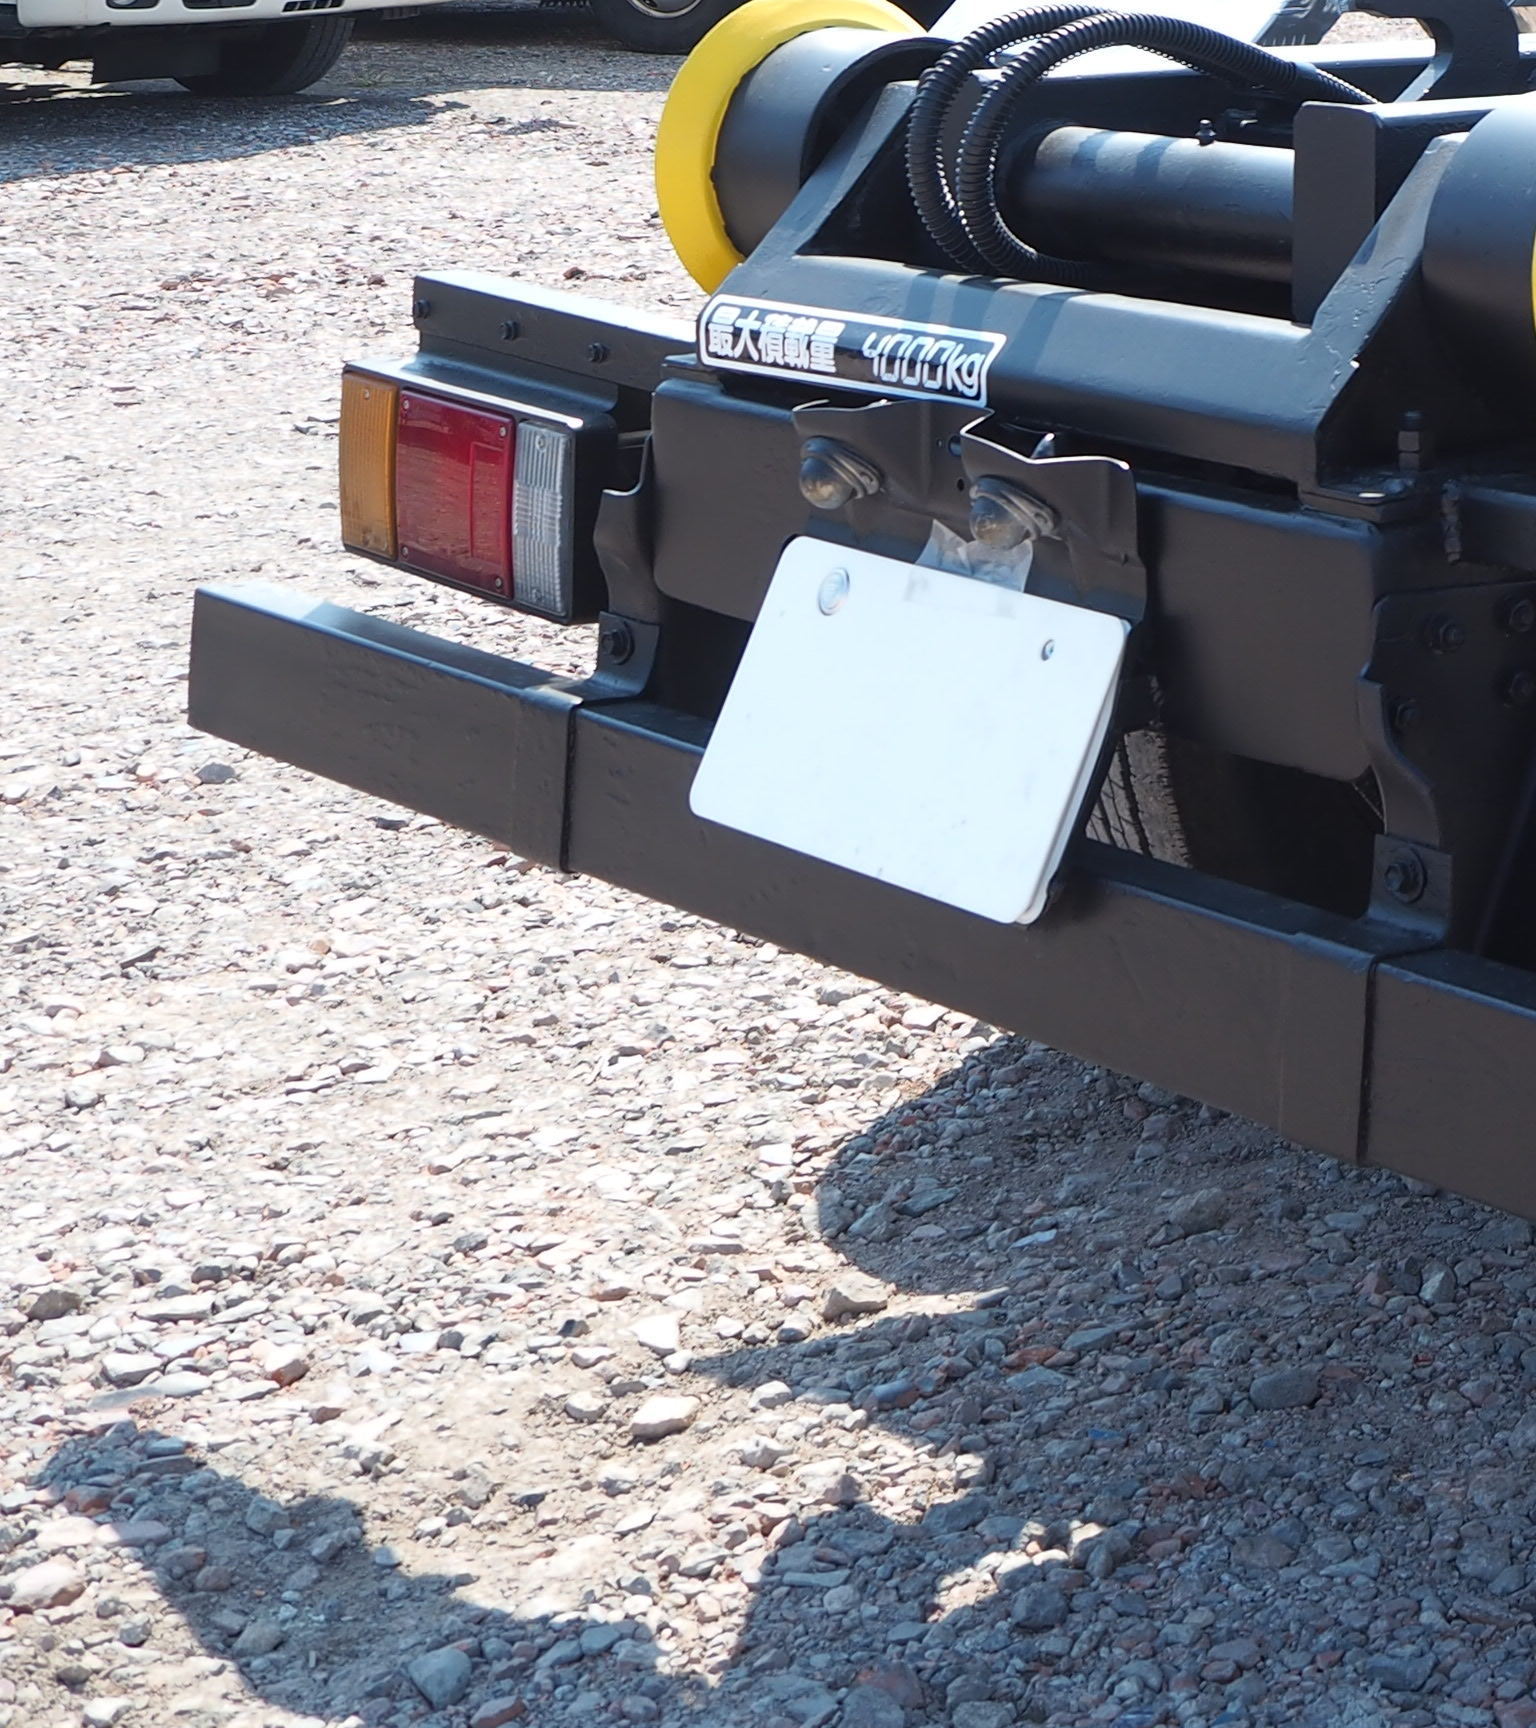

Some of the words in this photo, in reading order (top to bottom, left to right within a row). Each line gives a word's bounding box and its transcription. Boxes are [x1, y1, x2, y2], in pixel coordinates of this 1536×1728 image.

[707, 305, 846, 373] 最大積載量
[861, 331, 987, 397] 4000kg
